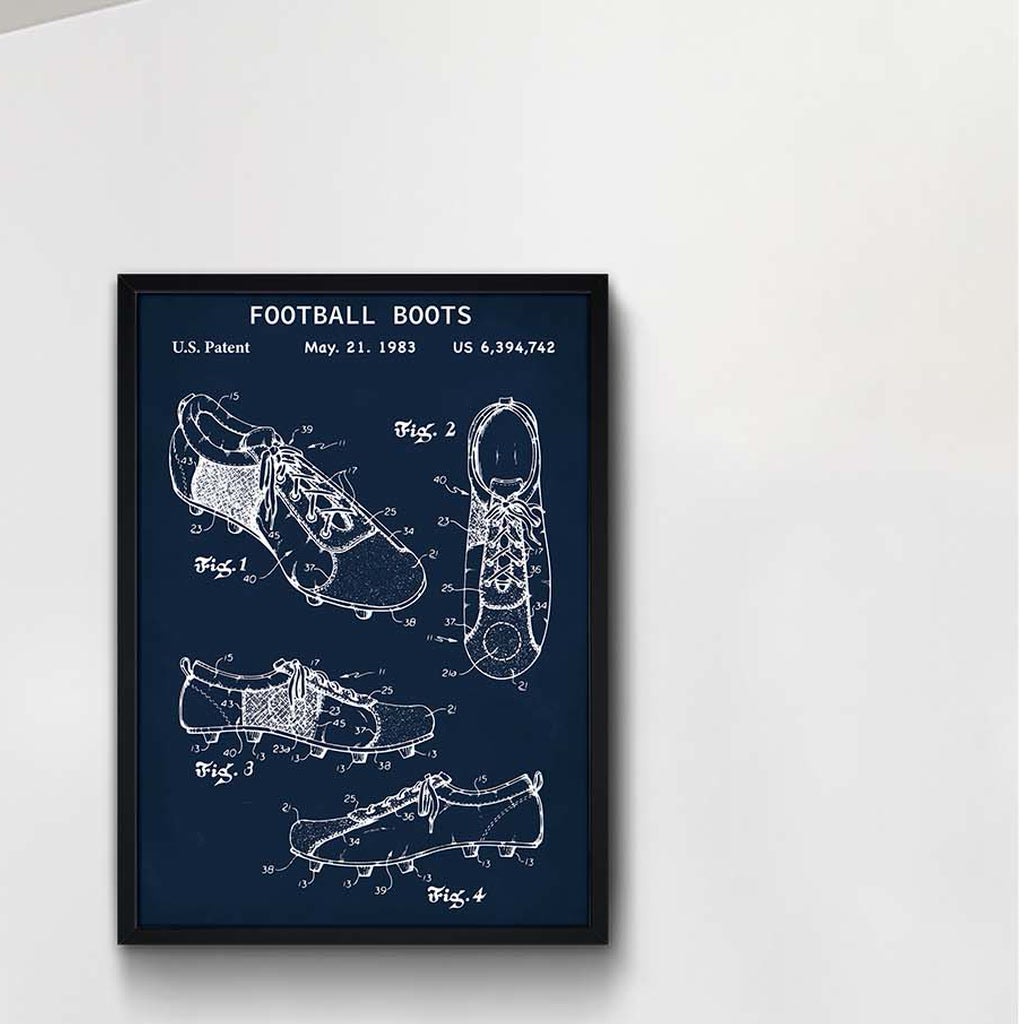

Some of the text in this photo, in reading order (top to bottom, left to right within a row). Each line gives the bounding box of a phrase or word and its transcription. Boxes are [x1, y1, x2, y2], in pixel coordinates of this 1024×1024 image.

[250, 305, 472, 325] FOOTBALL BOOTS
[172, 340, 251, 354] U.S. Patent
[304, 340, 416, 356] May. 21. 1983
[453, 340, 556, 356] US 6,394,742
[229, 392, 240, 400] 15
[301, 425, 314, 434] 39
[394, 419, 456, 444] Fig. 2
[347, 466, 358, 475] 17
[433, 476, 448, 485] 40
[384, 506, 398, 516] 25
[437, 516, 450, 526] 23
[190, 524, 202, 534] 23
[403, 527, 414, 536] 34
[243, 574, 257, 584] 40
[441, 584, 454, 593] 25
[536, 601, 548, 610] 34
[403, 618, 416, 627] 38
[444, 617, 456, 626] 37
[224, 654, 234, 662] 15
[380, 686, 394, 695] 25
[329, 706, 342, 716] 23
[332, 719, 347, 728] 45
[354, 726, 367, 735] 37
[191, 744, 201, 753] 13
[223, 749, 237, 758] 40
[256, 753, 266, 762] 13
[428, 750, 438, 758] 13
[290, 756, 300, 764] 13
[336, 764, 346, 773] 13
[378, 762, 392, 771] 38
[195, 761, 254, 786] Fig. 3
[478, 775, 488, 784] 15
[344, 794, 356, 804] 25
[402, 812, 415, 822] 36
[349, 837, 360, 846] 34
[482, 860, 491, 868] 13
[525, 858, 534, 867] 13
[262, 865, 274, 874] 38
[423, 874, 432, 882] 13
[298, 880, 308, 888] 13
[343, 880, 352, 888] 13
[375, 886, 387, 896] 39
